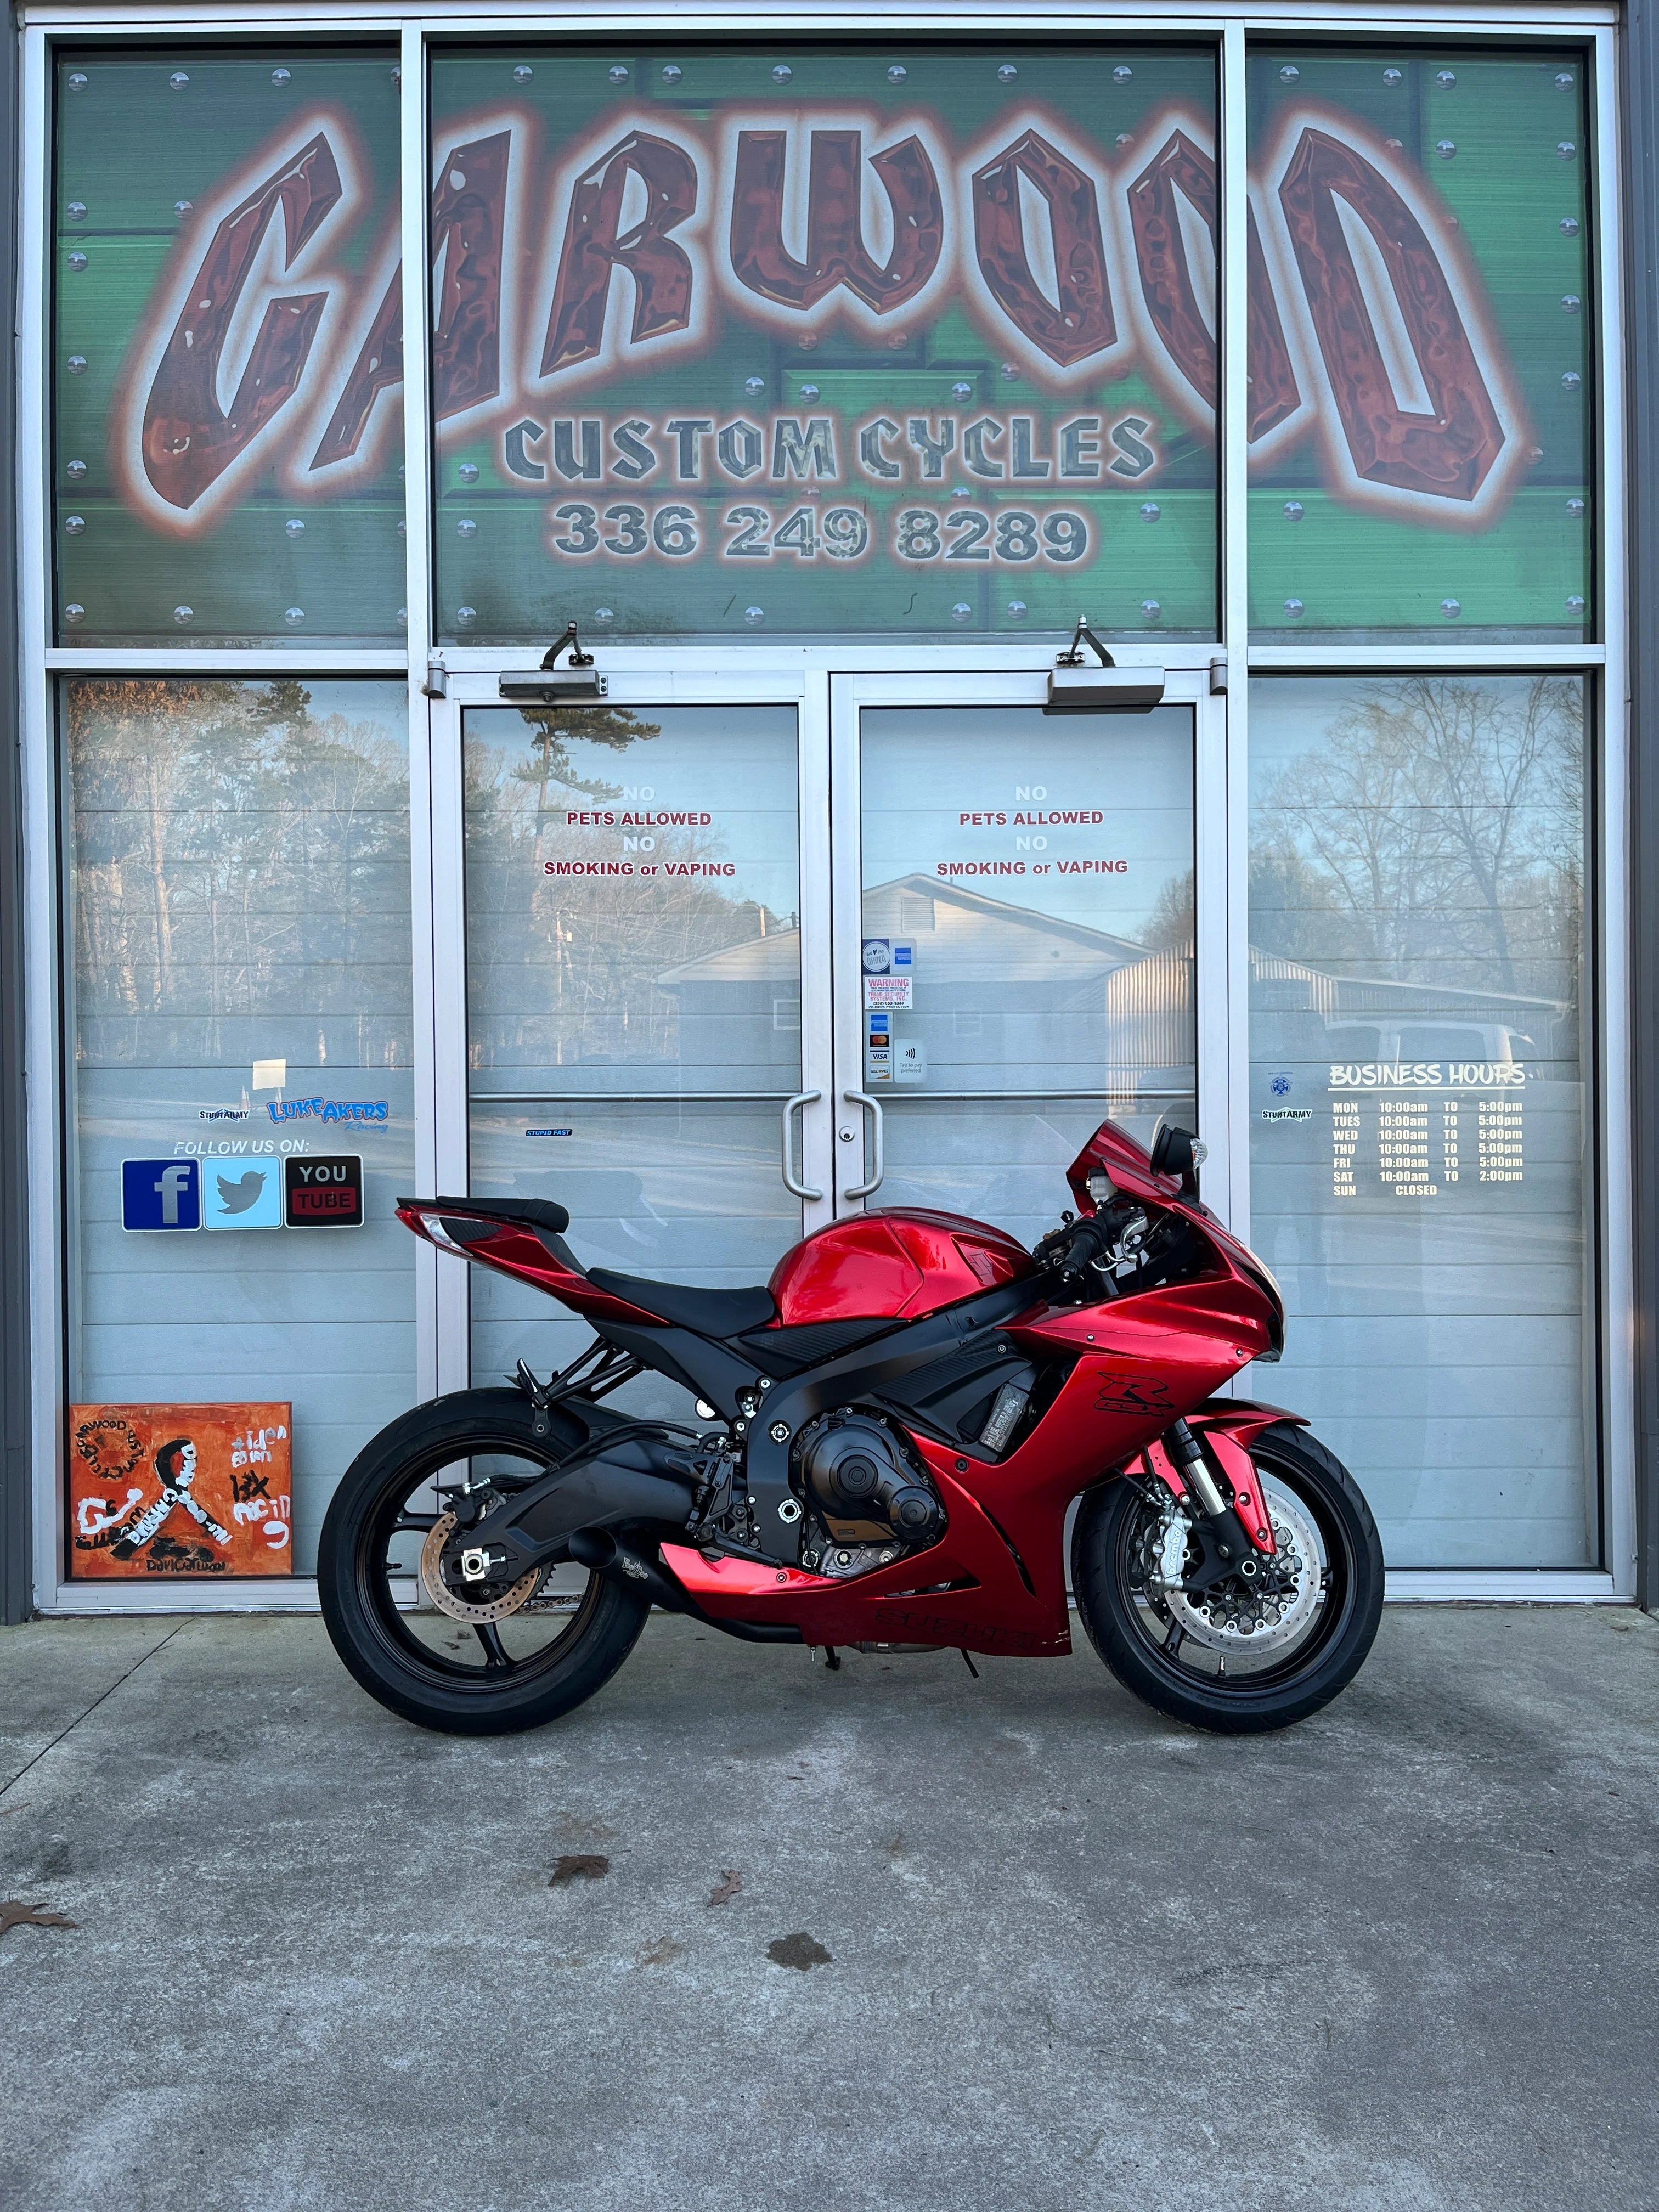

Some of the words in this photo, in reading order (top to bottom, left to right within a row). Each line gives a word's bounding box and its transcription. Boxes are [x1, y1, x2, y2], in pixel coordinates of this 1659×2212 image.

[140, 126, 1507, 511] GARWOOD
[505, 418, 837, 480] CUSTOM
[860, 416, 1156, 479] CYCLES
[555, 505, 698, 555] 336
[725, 506, 868, 558] 249
[896, 510, 1087, 561] 8289
[623, 786, 655, 802] NO
[1015, 786, 1047, 801] NO
[567, 812, 615, 825] PETS
[620, 812, 712, 826] ALLOWED
[960, 812, 1007, 826] PETS
[1013, 811, 1103, 825] ALLOWED
[623, 836, 655, 851] NO
[1016, 836, 1047, 851] NO
[544, 862, 634, 875] SMOKING
[640, 865, 658, 876] or
[664, 862, 736, 876] VAPING
[937, 862, 1026, 876] SMOKING
[1032, 865, 1051, 874] or
[1057, 860, 1128, 873] VAPING
[868, 978, 909, 987] WARNING
[1329, 1064, 1443, 1086] BUSINESS
[1449, 1063, 1526, 1085] HOURS
[1333, 1102, 1358, 1113] MON
[1379, 1102, 1429, 1113] 10:00am
[1443, 1101, 1458, 1112] TO
[1478, 1101, 1523, 1114] 5:00pm
[345, 1121, 389, 1133] Racing
[1333, 1116, 1361, 1127] TUES
[1378, 1116, 1428, 1127] 10:00am
[1443, 1115, 1458, 1126] TO
[1478, 1115, 1523, 1127] 5:00pm
[1333, 1130, 1358, 1141] WED
[1379, 1130, 1429, 1141] 10:00am
[1443, 1129, 1458, 1140] TO
[1478, 1129, 1523, 1141] 5:00pm
[173, 1140, 247, 1155] FOLLOW
[251, 1139, 275, 1154] US
[279, 1138, 311, 1153] ON:
[1333, 1144, 1355, 1154] THU
[1379, 1143, 1428, 1154] 10:00am
[1443, 1143, 1458, 1154] TO
[1478, 1143, 1523, 1155] 5:00pm
[1333, 1158, 1351, 1169] FRI
[1379, 1157, 1429, 1169] 10:00am
[1443, 1157, 1459, 1168] TO
[1479, 1156, 1523, 1169] 5:00pm
[298, 1166, 347, 1183] YOU
[1333, 1172, 1354, 1182] SAT
[1379, 1171, 1429, 1182] 10:00am
[1444, 1171, 1459, 1182] TO
[1479, 1170, 1523, 1182] 2:00pm
[1333, 1186, 1356, 1196] SUN
[1395, 1185, 1437, 1196] CLOSED
[297, 1192, 352, 1211] TUBE
[1166, 1529, 1182, 1575] brembo
[874, 1607, 1037, 1649] SUZUKI
